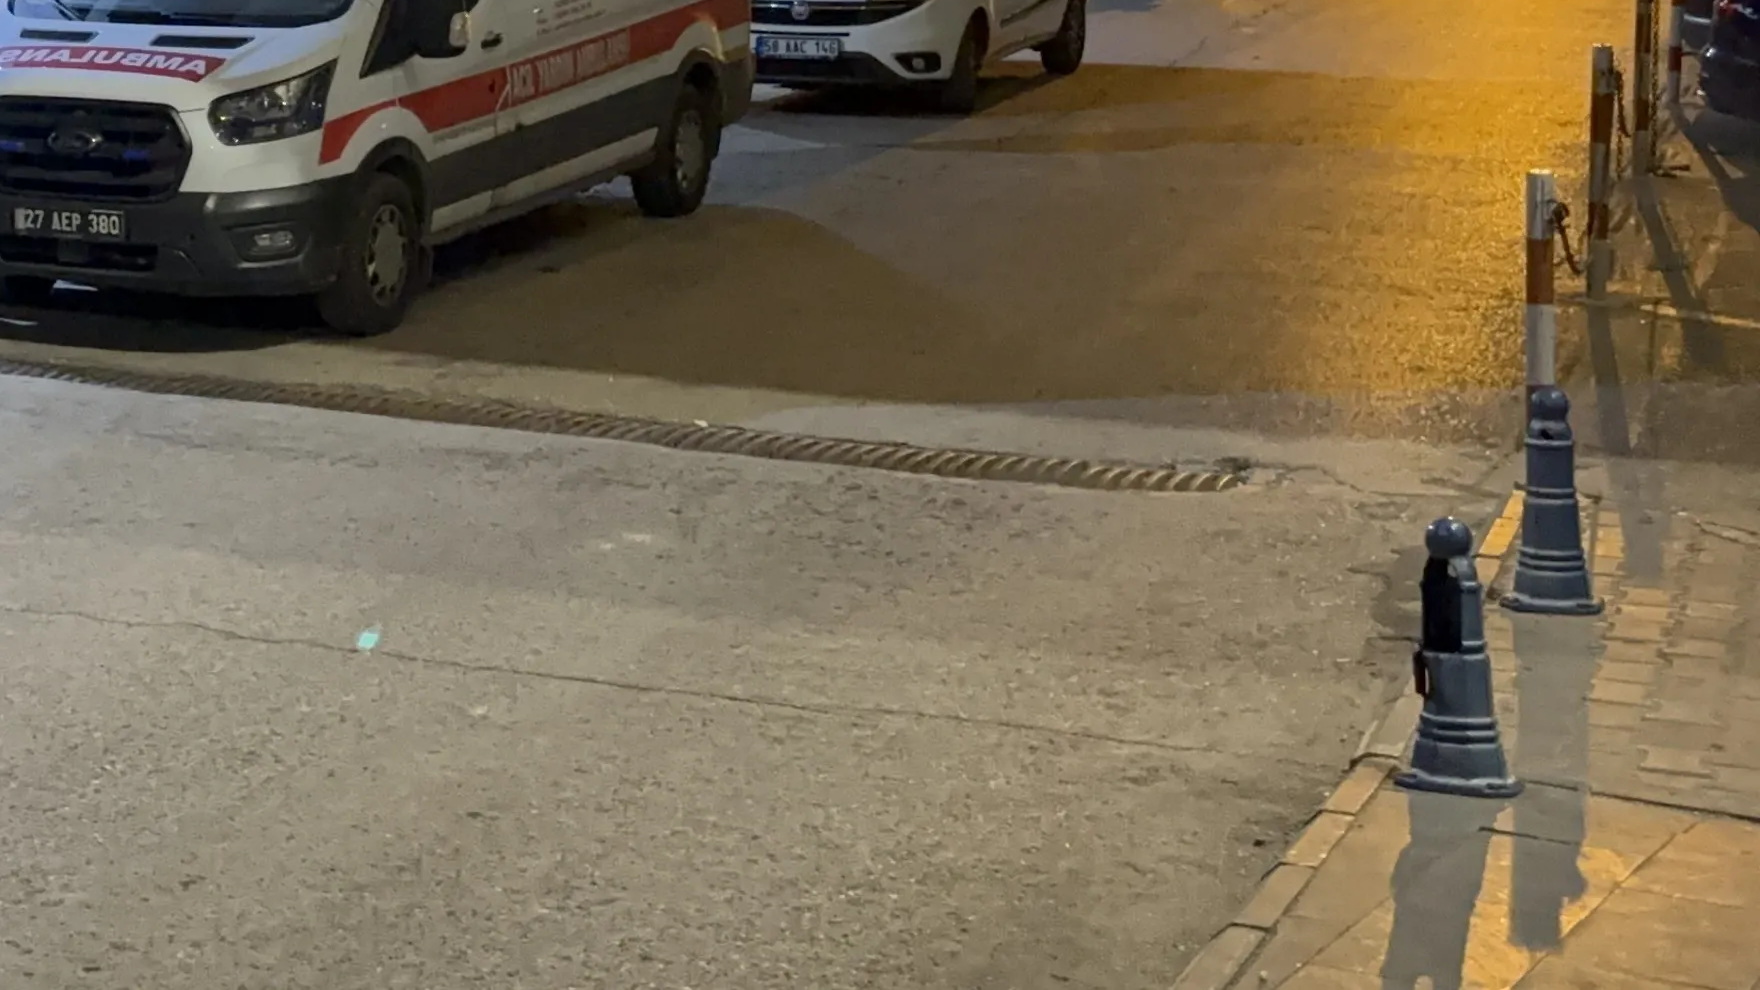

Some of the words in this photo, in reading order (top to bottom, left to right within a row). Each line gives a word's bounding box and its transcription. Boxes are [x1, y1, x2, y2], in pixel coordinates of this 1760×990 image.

[25, 209, 45, 229] 27
[51, 211, 81, 232] AEP
[88, 213, 120, 235] 380
